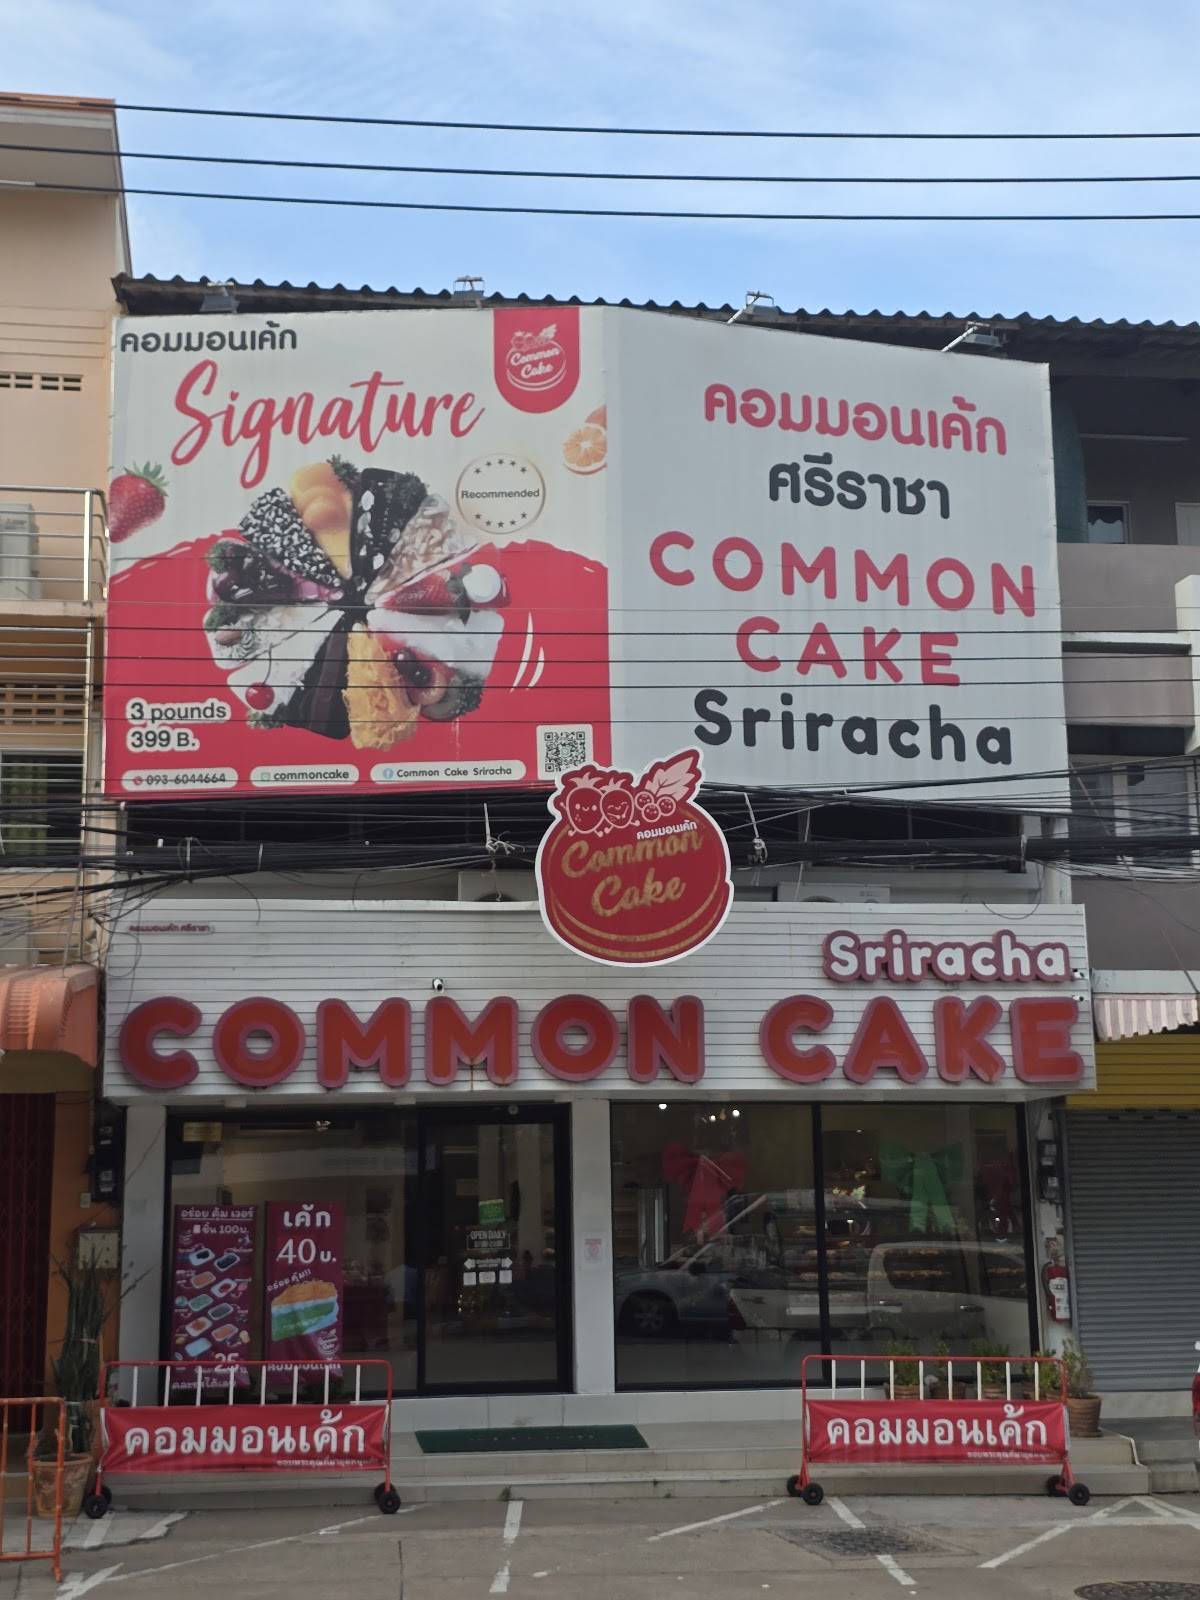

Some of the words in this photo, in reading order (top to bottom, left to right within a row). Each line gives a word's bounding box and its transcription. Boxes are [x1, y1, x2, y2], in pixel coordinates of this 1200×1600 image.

[120, 321, 297, 353] คอมมอนเค้ก
[510, 347, 560, 366] Common
[521, 361, 553, 378] Cake
[171, 359, 485, 489] Signature
[704, 384, 1006, 455] คอมมอนเค้ก
[461, 489, 540, 501] Recommended
[769, 452, 950, 519] ศรีราชา
[649, 531, 1035, 617] COMMON
[736, 616, 960, 686] CAKE
[130, 702, 144, 720] 3
[151, 702, 226, 723] pounds
[694, 689, 1011, 765] Sriracha
[130, 730, 171, 748] 399
[177, 732, 196, 747] B.
[273, 769, 350, 781] commoncake
[397, 768, 439, 778] Common
[444, 767, 468, 777] Cake
[473, 766, 512, 776] Sriracha
[562, 832, 702, 878] Common
[592, 868, 686, 917] Cake
[825, 931, 1070, 981] Sriracha
[119, 994, 704, 1089] COMMON
[760, 994, 1084, 1084] CAKE
[283, 1204, 331, 1227] เค้ก
[125, 1409, 364, 1455] คอมมอนเค้ก
[827, 1403, 1046, 1445] คอมมอนเค้ก
